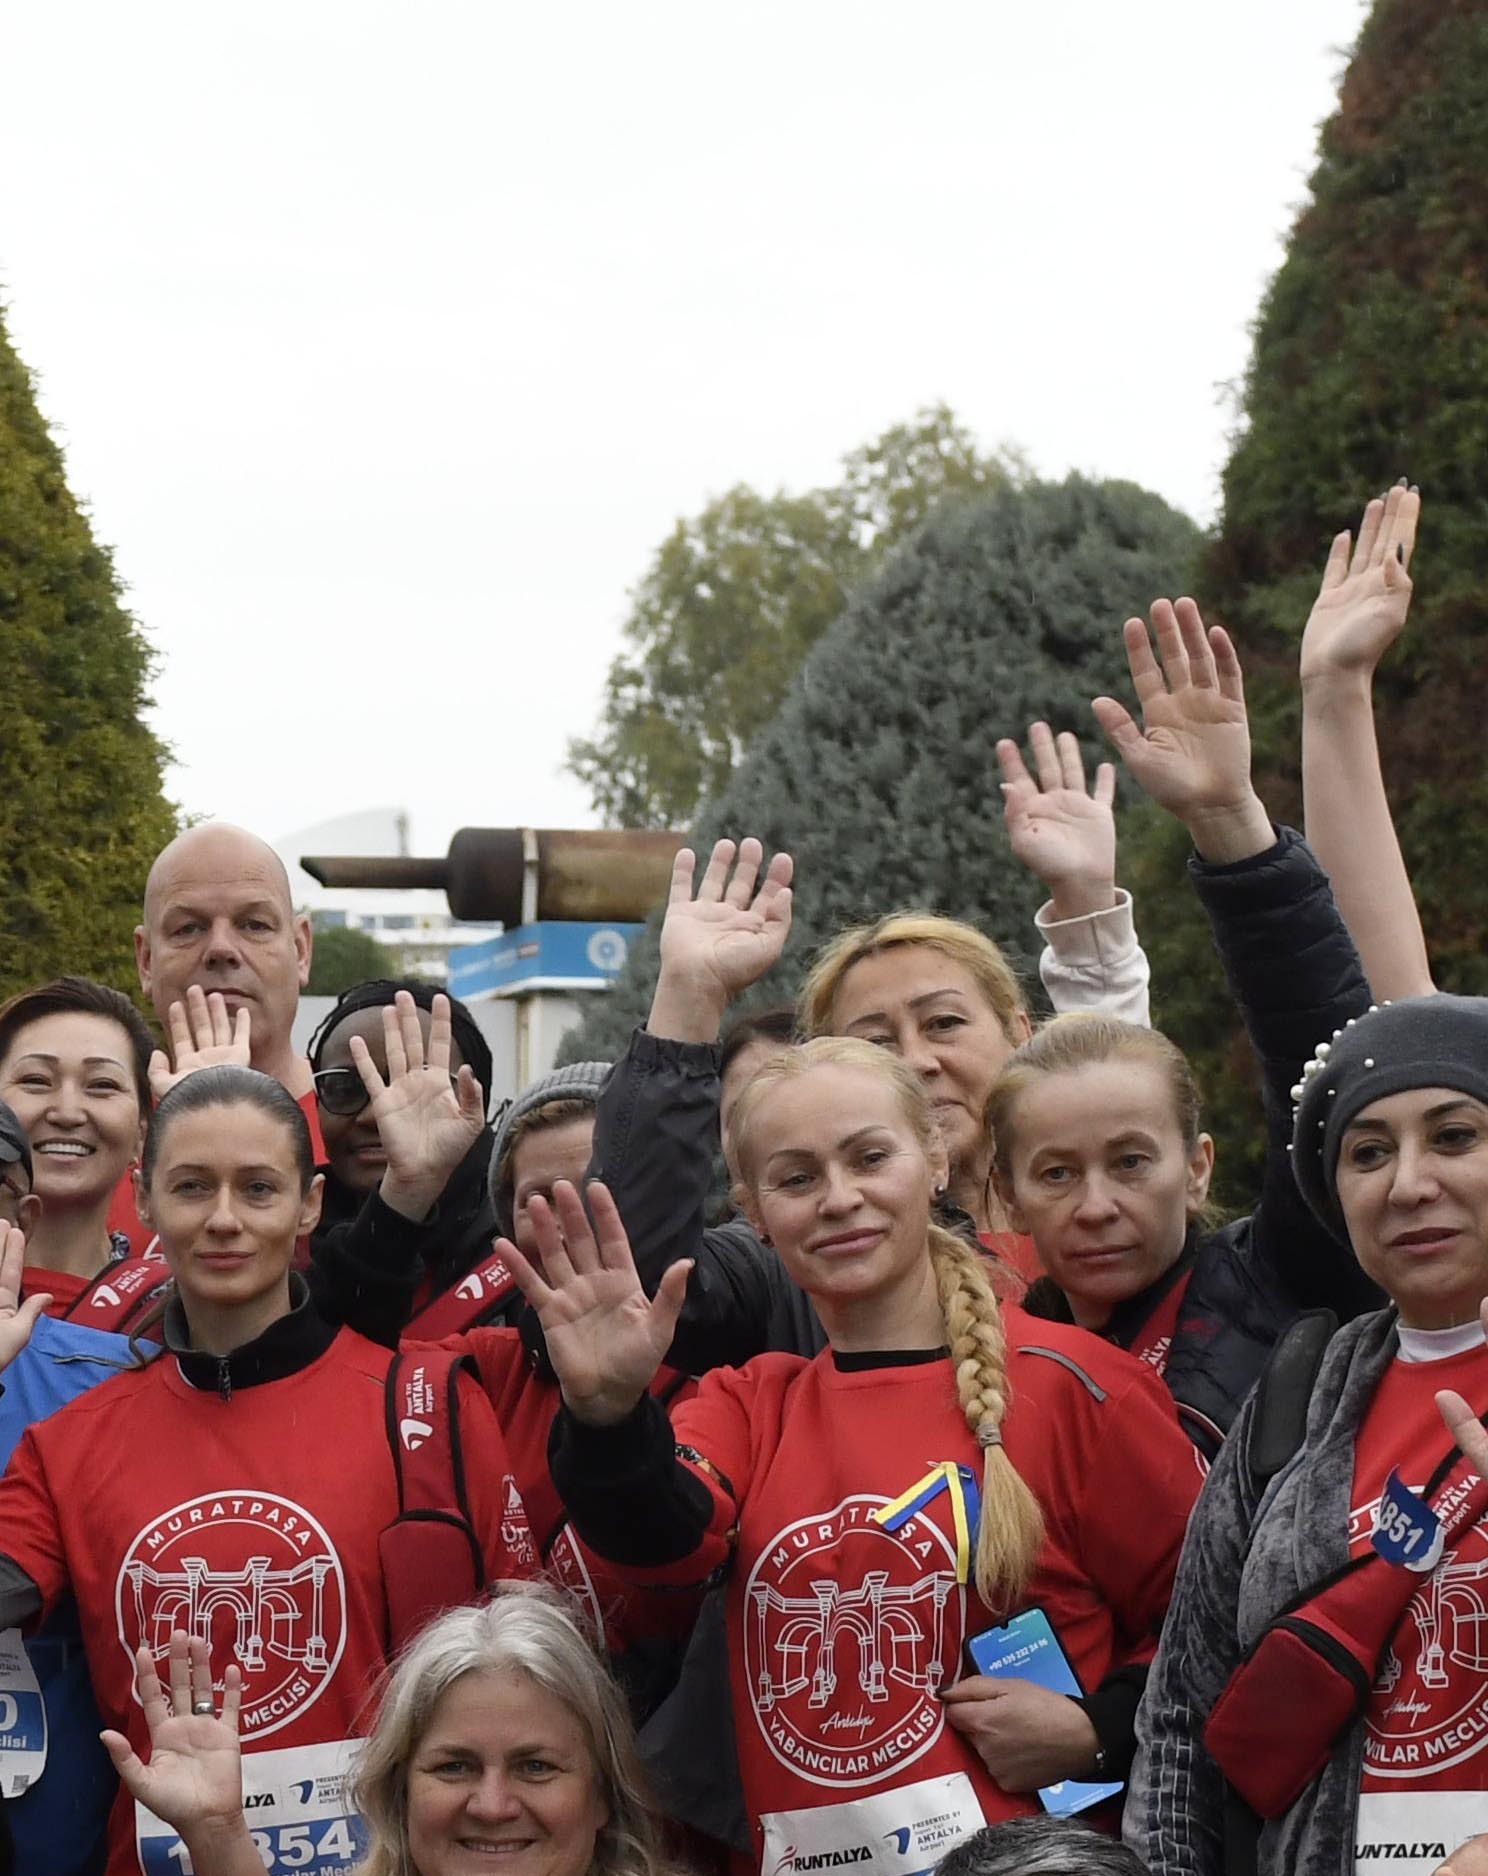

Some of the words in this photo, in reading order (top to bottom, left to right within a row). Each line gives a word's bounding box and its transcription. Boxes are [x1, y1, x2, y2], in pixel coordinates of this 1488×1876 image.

[412, 1366, 424, 1414] ANTALYA
[146, 1501, 311, 1548] MURATPAŞA
[243, 1676, 311, 1729] MECLİSİ
[770, 1716, 869, 1774] YABANCILAR
[873, 1705, 937, 1768] MECLİSİ
[912, 1816, 950, 1830] PRESENTED
[917, 1826, 962, 1846] ANTALYA
[794, 1846, 873, 1872] RUNTALYA
[1355, 1842, 1446, 1859] UNTALYA
